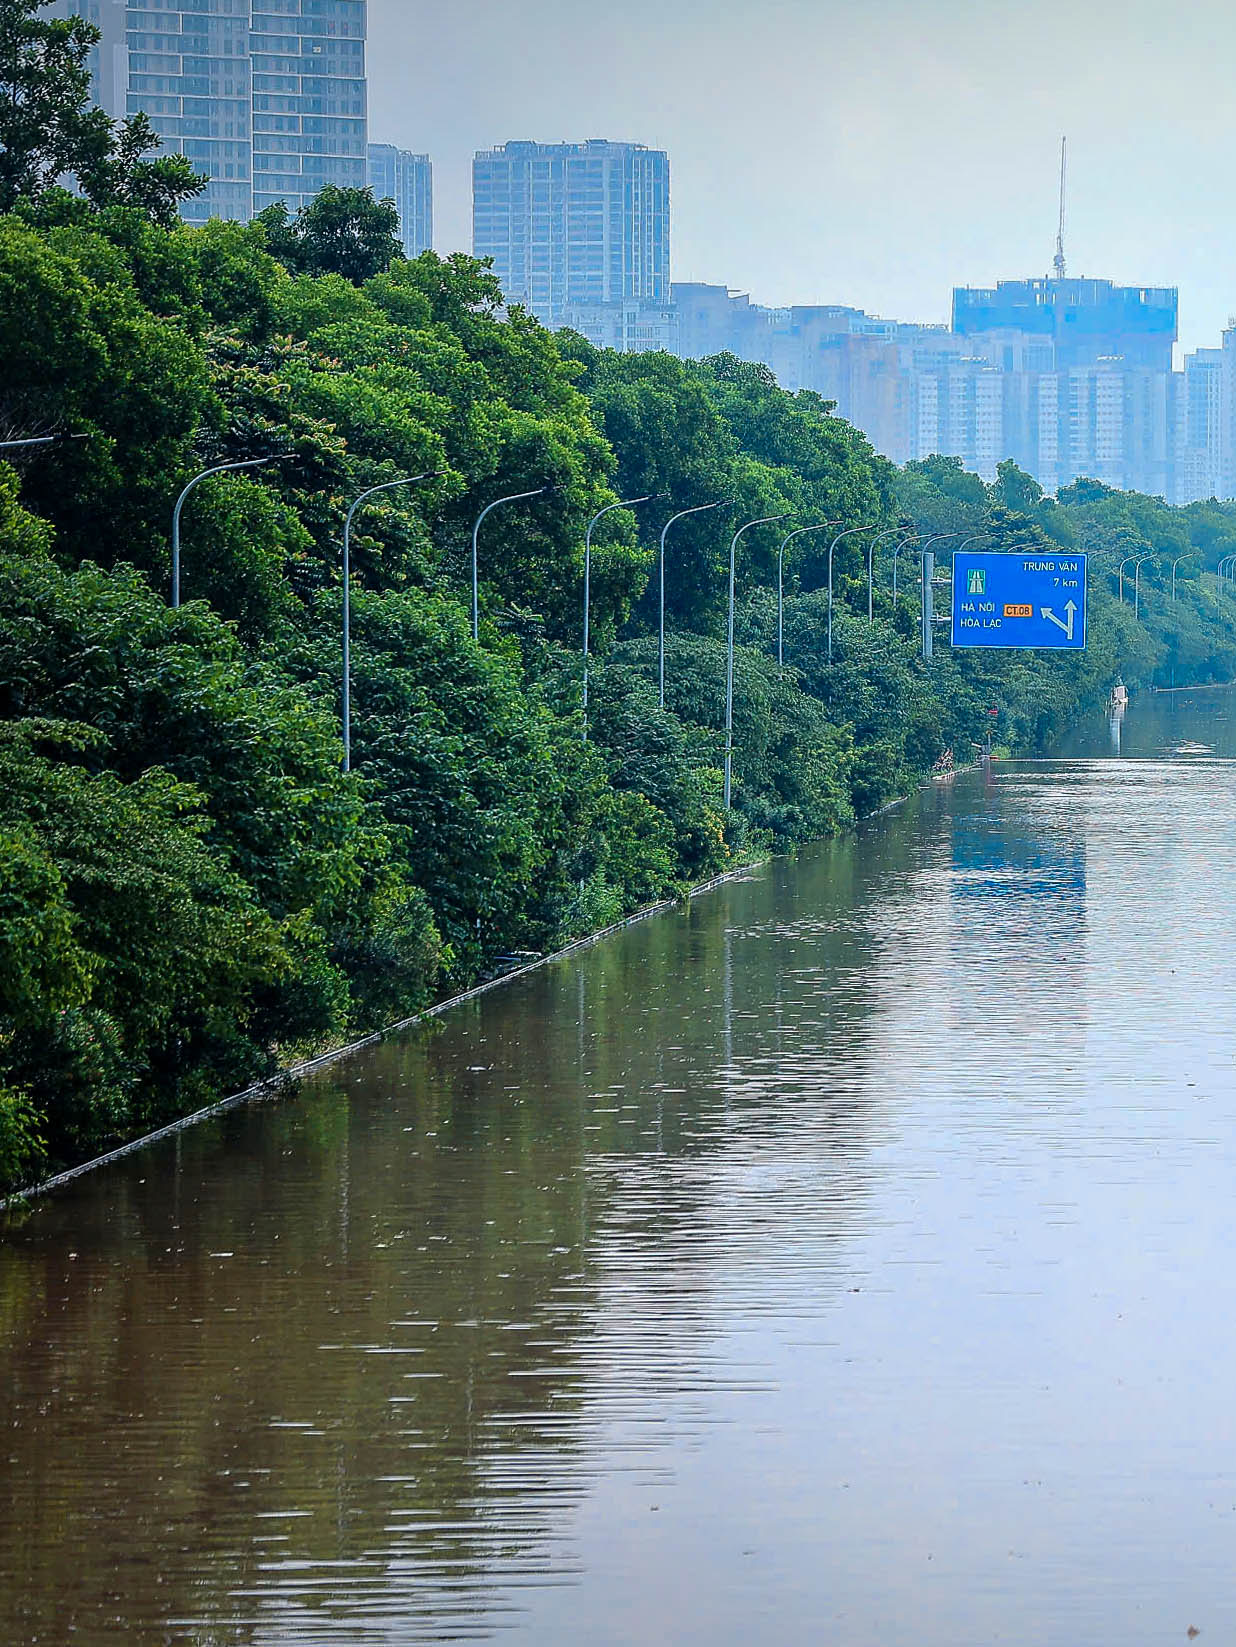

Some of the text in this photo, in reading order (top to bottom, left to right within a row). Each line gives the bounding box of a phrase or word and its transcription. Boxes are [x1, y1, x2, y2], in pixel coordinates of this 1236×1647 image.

[1023, 562, 1055, 571] TRUNG
[1053, 578, 1078, 587] 7 km
[961, 600, 996, 614] HÀ NỘI
[960, 616, 1002, 630] HÒA LẠC
